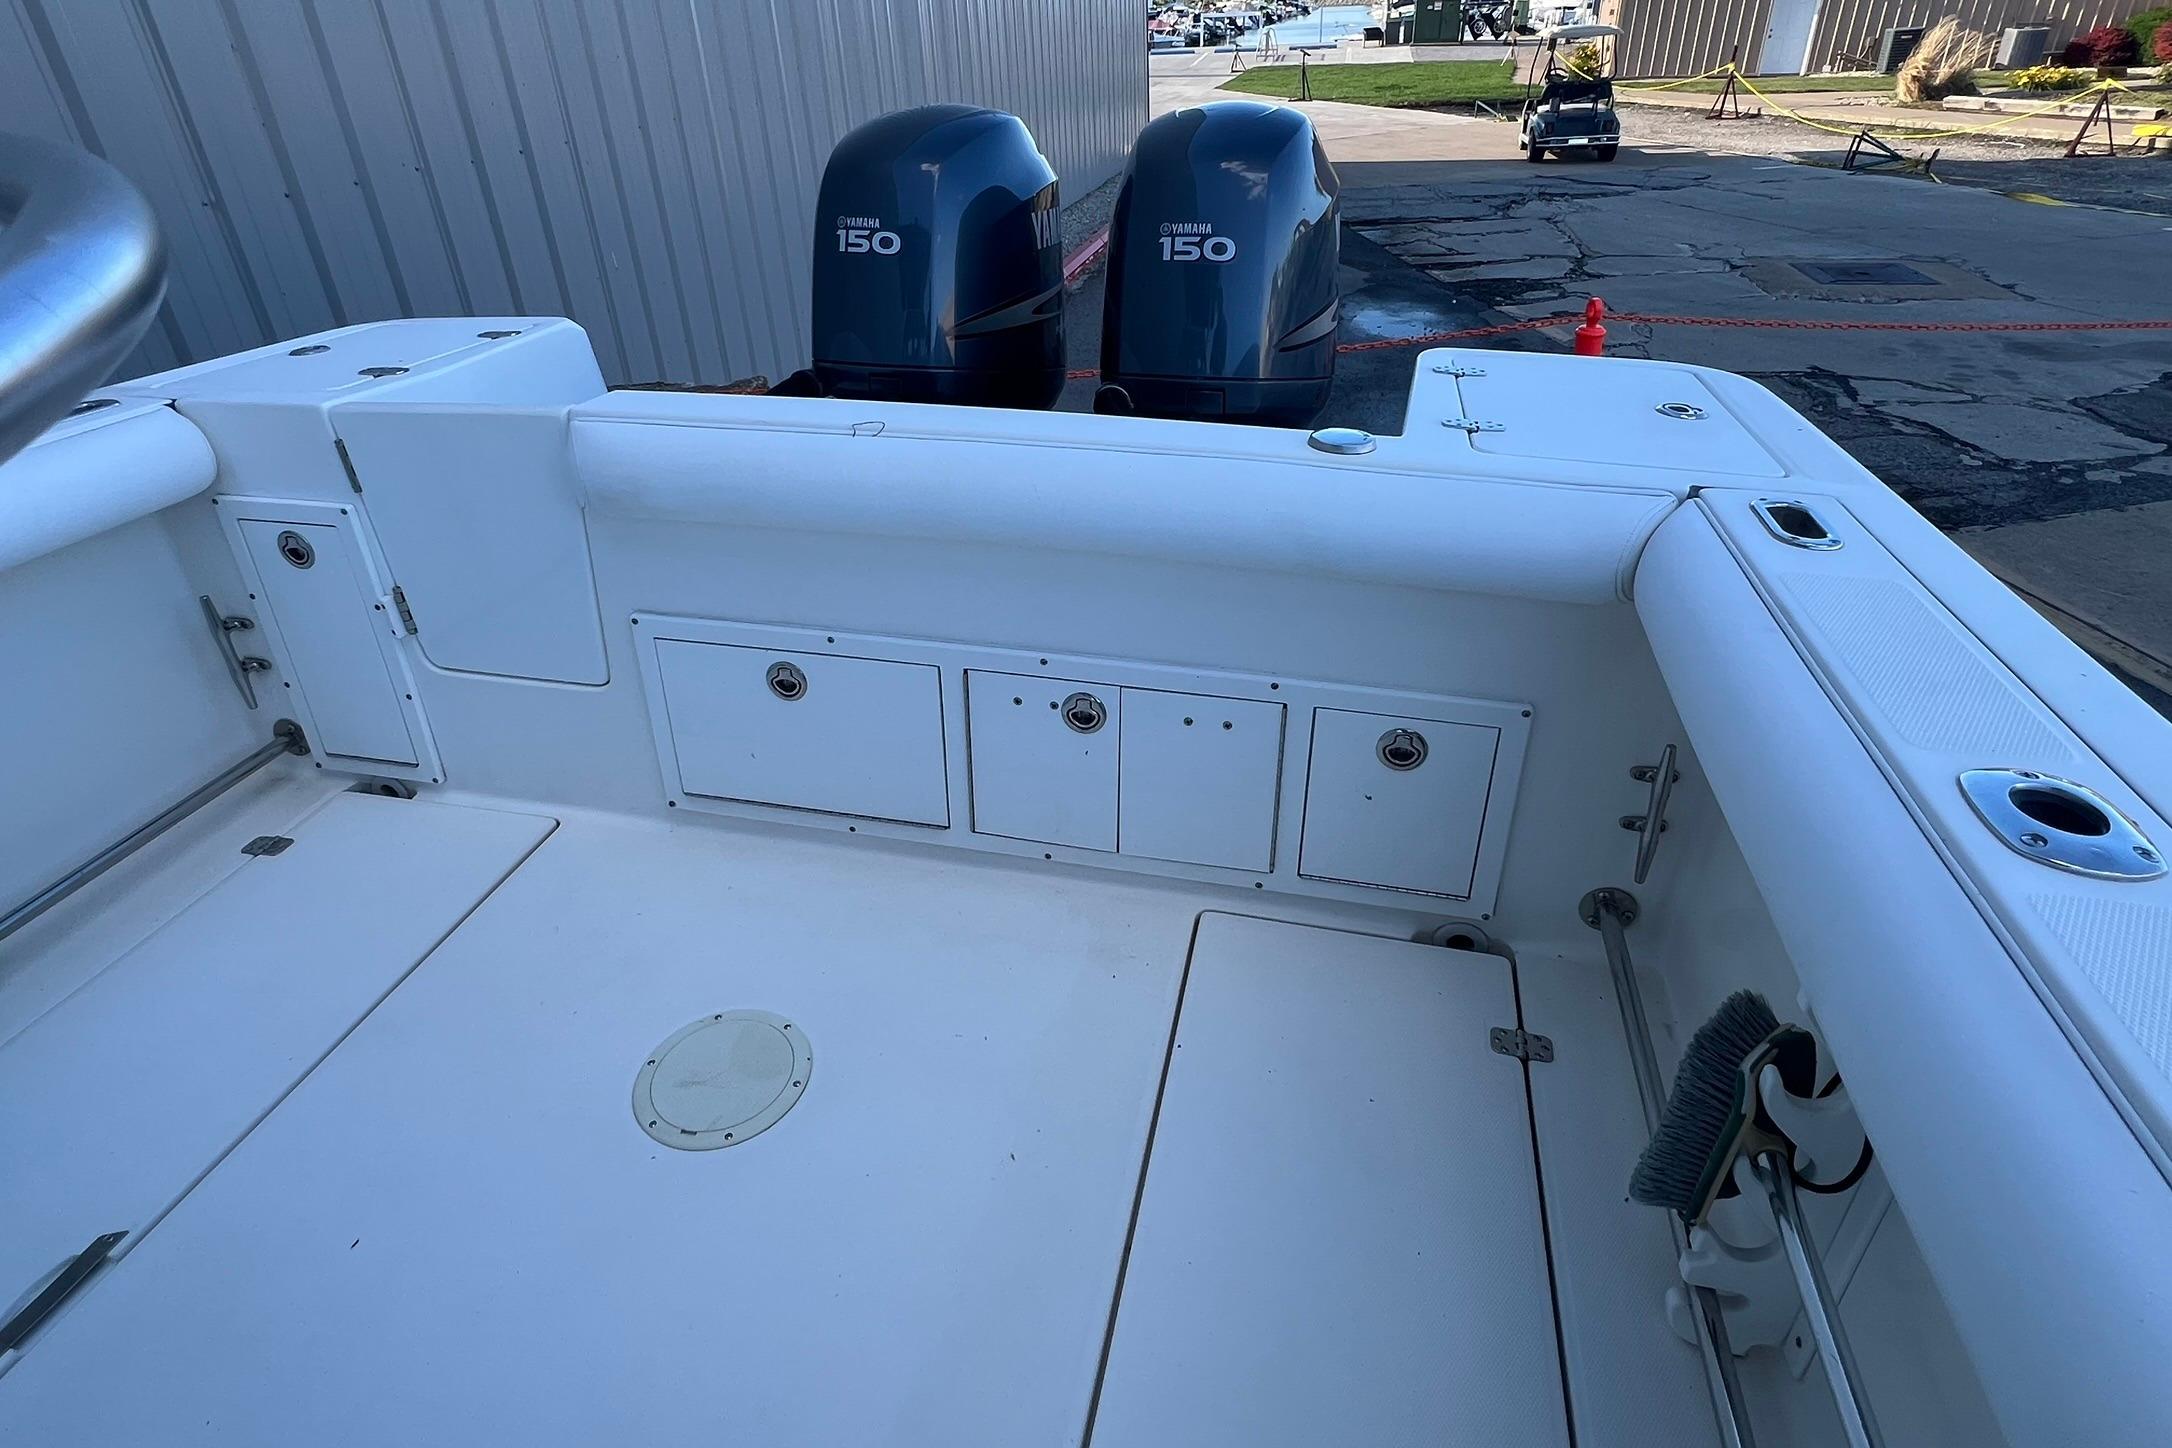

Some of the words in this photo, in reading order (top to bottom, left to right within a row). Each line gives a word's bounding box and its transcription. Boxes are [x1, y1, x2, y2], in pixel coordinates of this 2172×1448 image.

[847, 216, 880, 229] YAMAHA
[1171, 222, 1212, 235] YAMAHA
[836, 229, 901, 255] 150
[1159, 236, 1236, 262] 150
